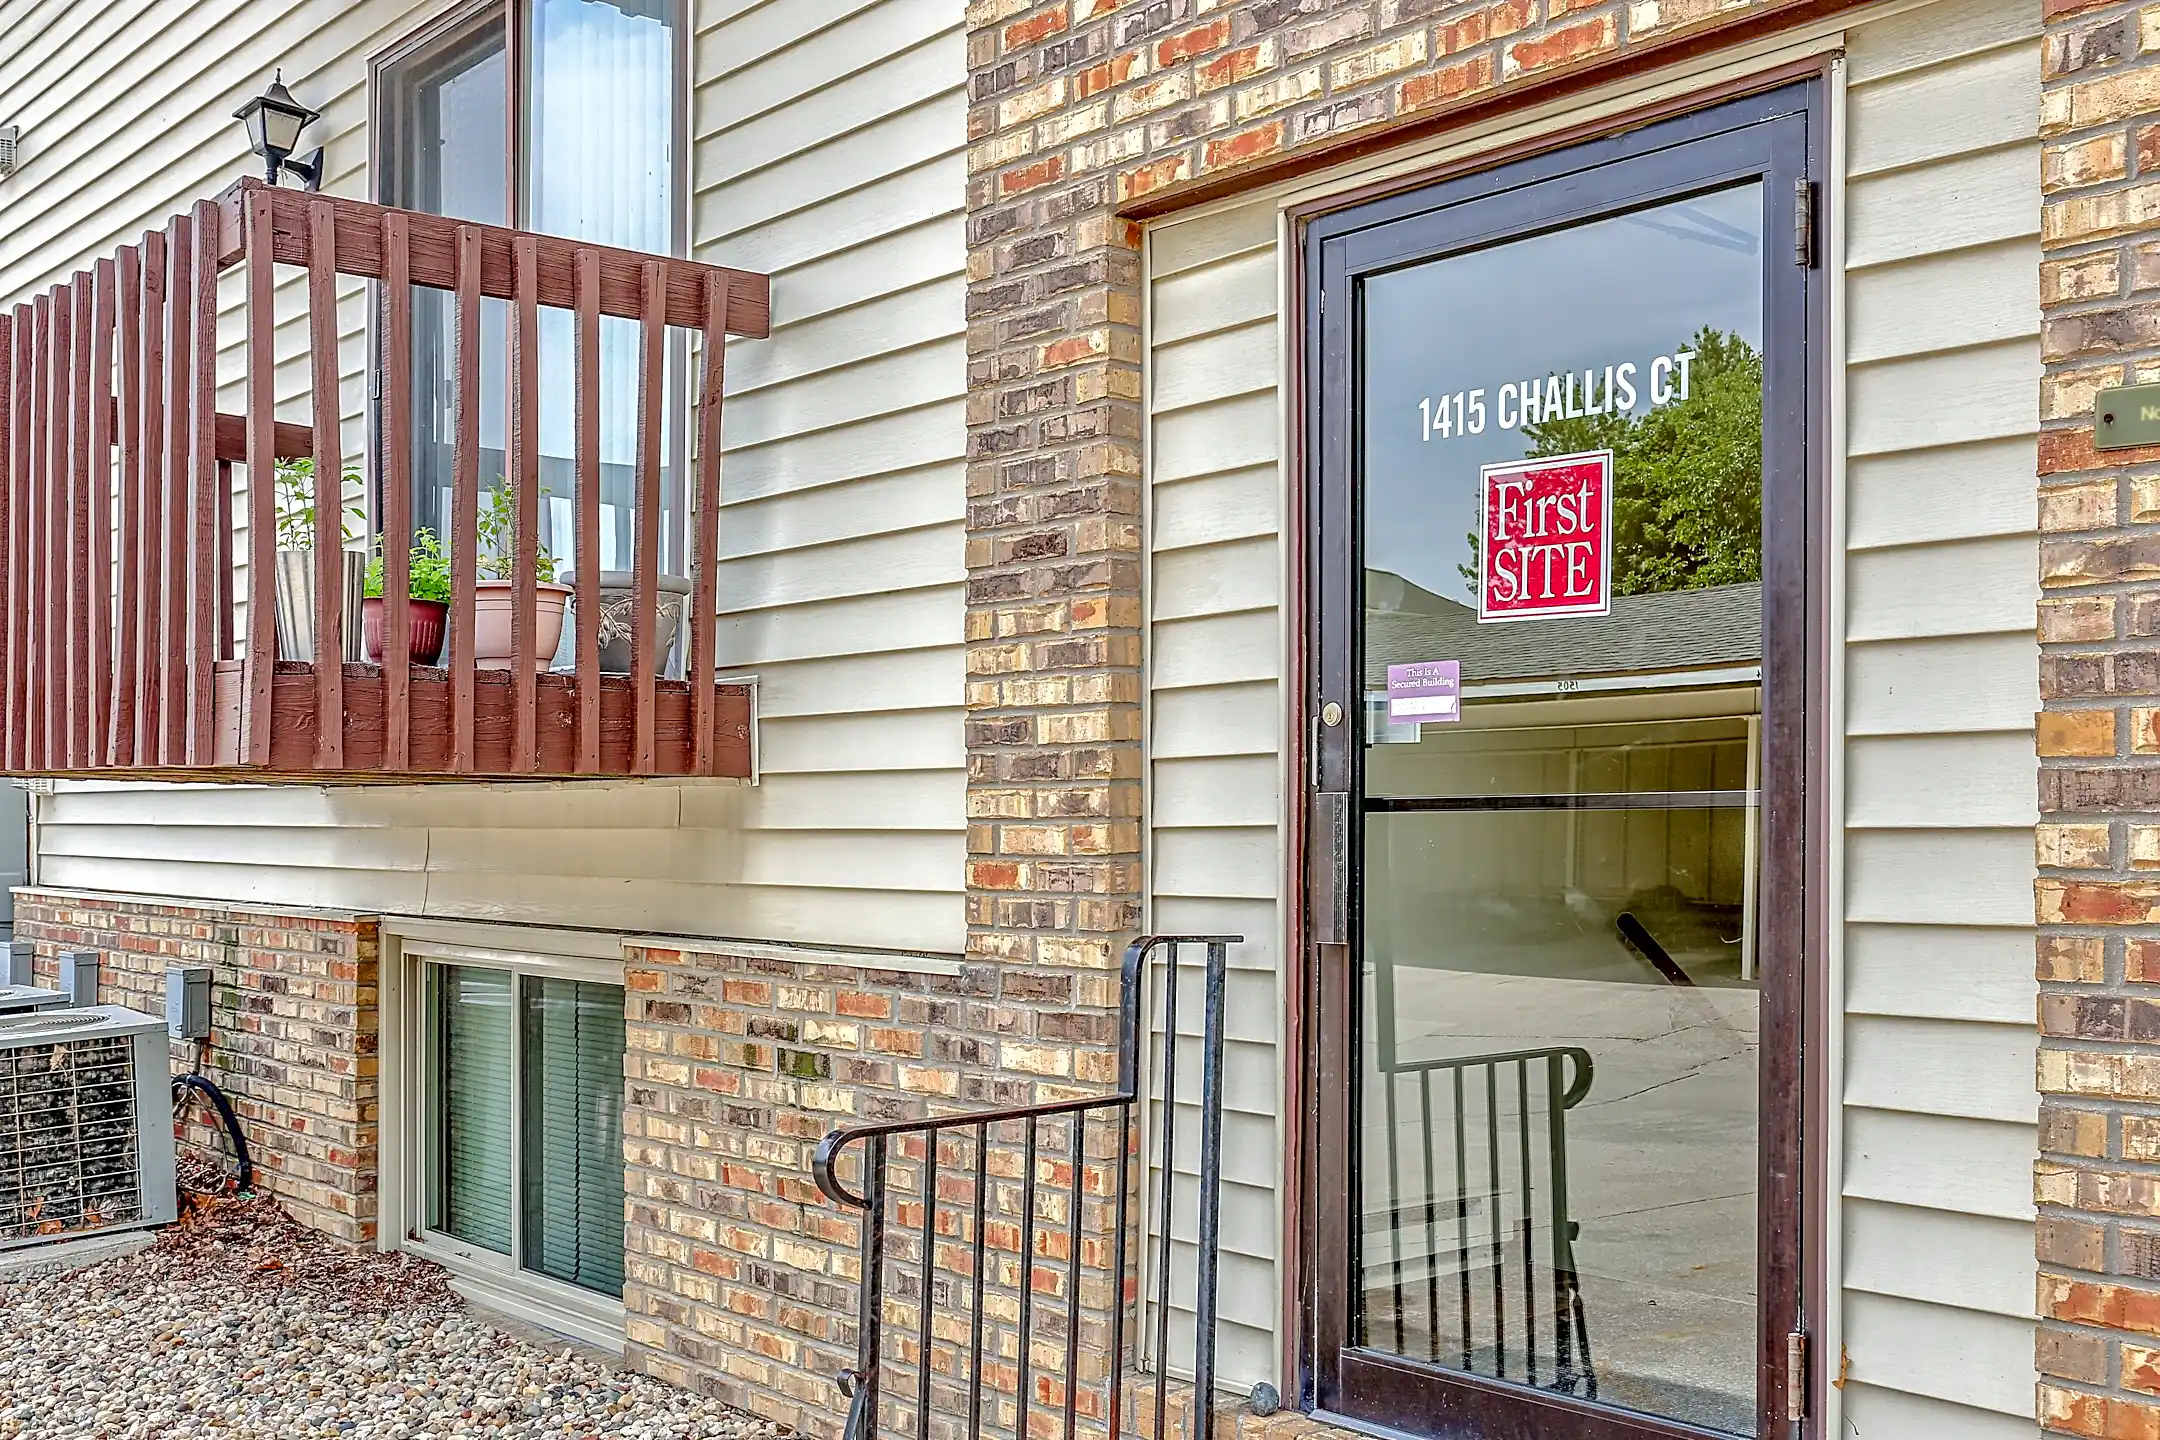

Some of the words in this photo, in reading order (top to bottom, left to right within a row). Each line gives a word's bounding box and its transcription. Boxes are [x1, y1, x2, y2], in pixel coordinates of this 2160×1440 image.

[1418, 389, 1486, 442] 1415
[1498, 362, 1637, 430] CHALLIS
[1650, 351, 1696, 405] CT
[1493, 478, 1595, 541] First
[1493, 541, 1594, 602] SITE
[1391, 679, 1421, 689] Secured
[1422, 676, 1455, 688] Building
[1406, 667, 1423, 678] This
[1424, 667, 1432, 676] Is
[1432, 666, 1440, 676] A
